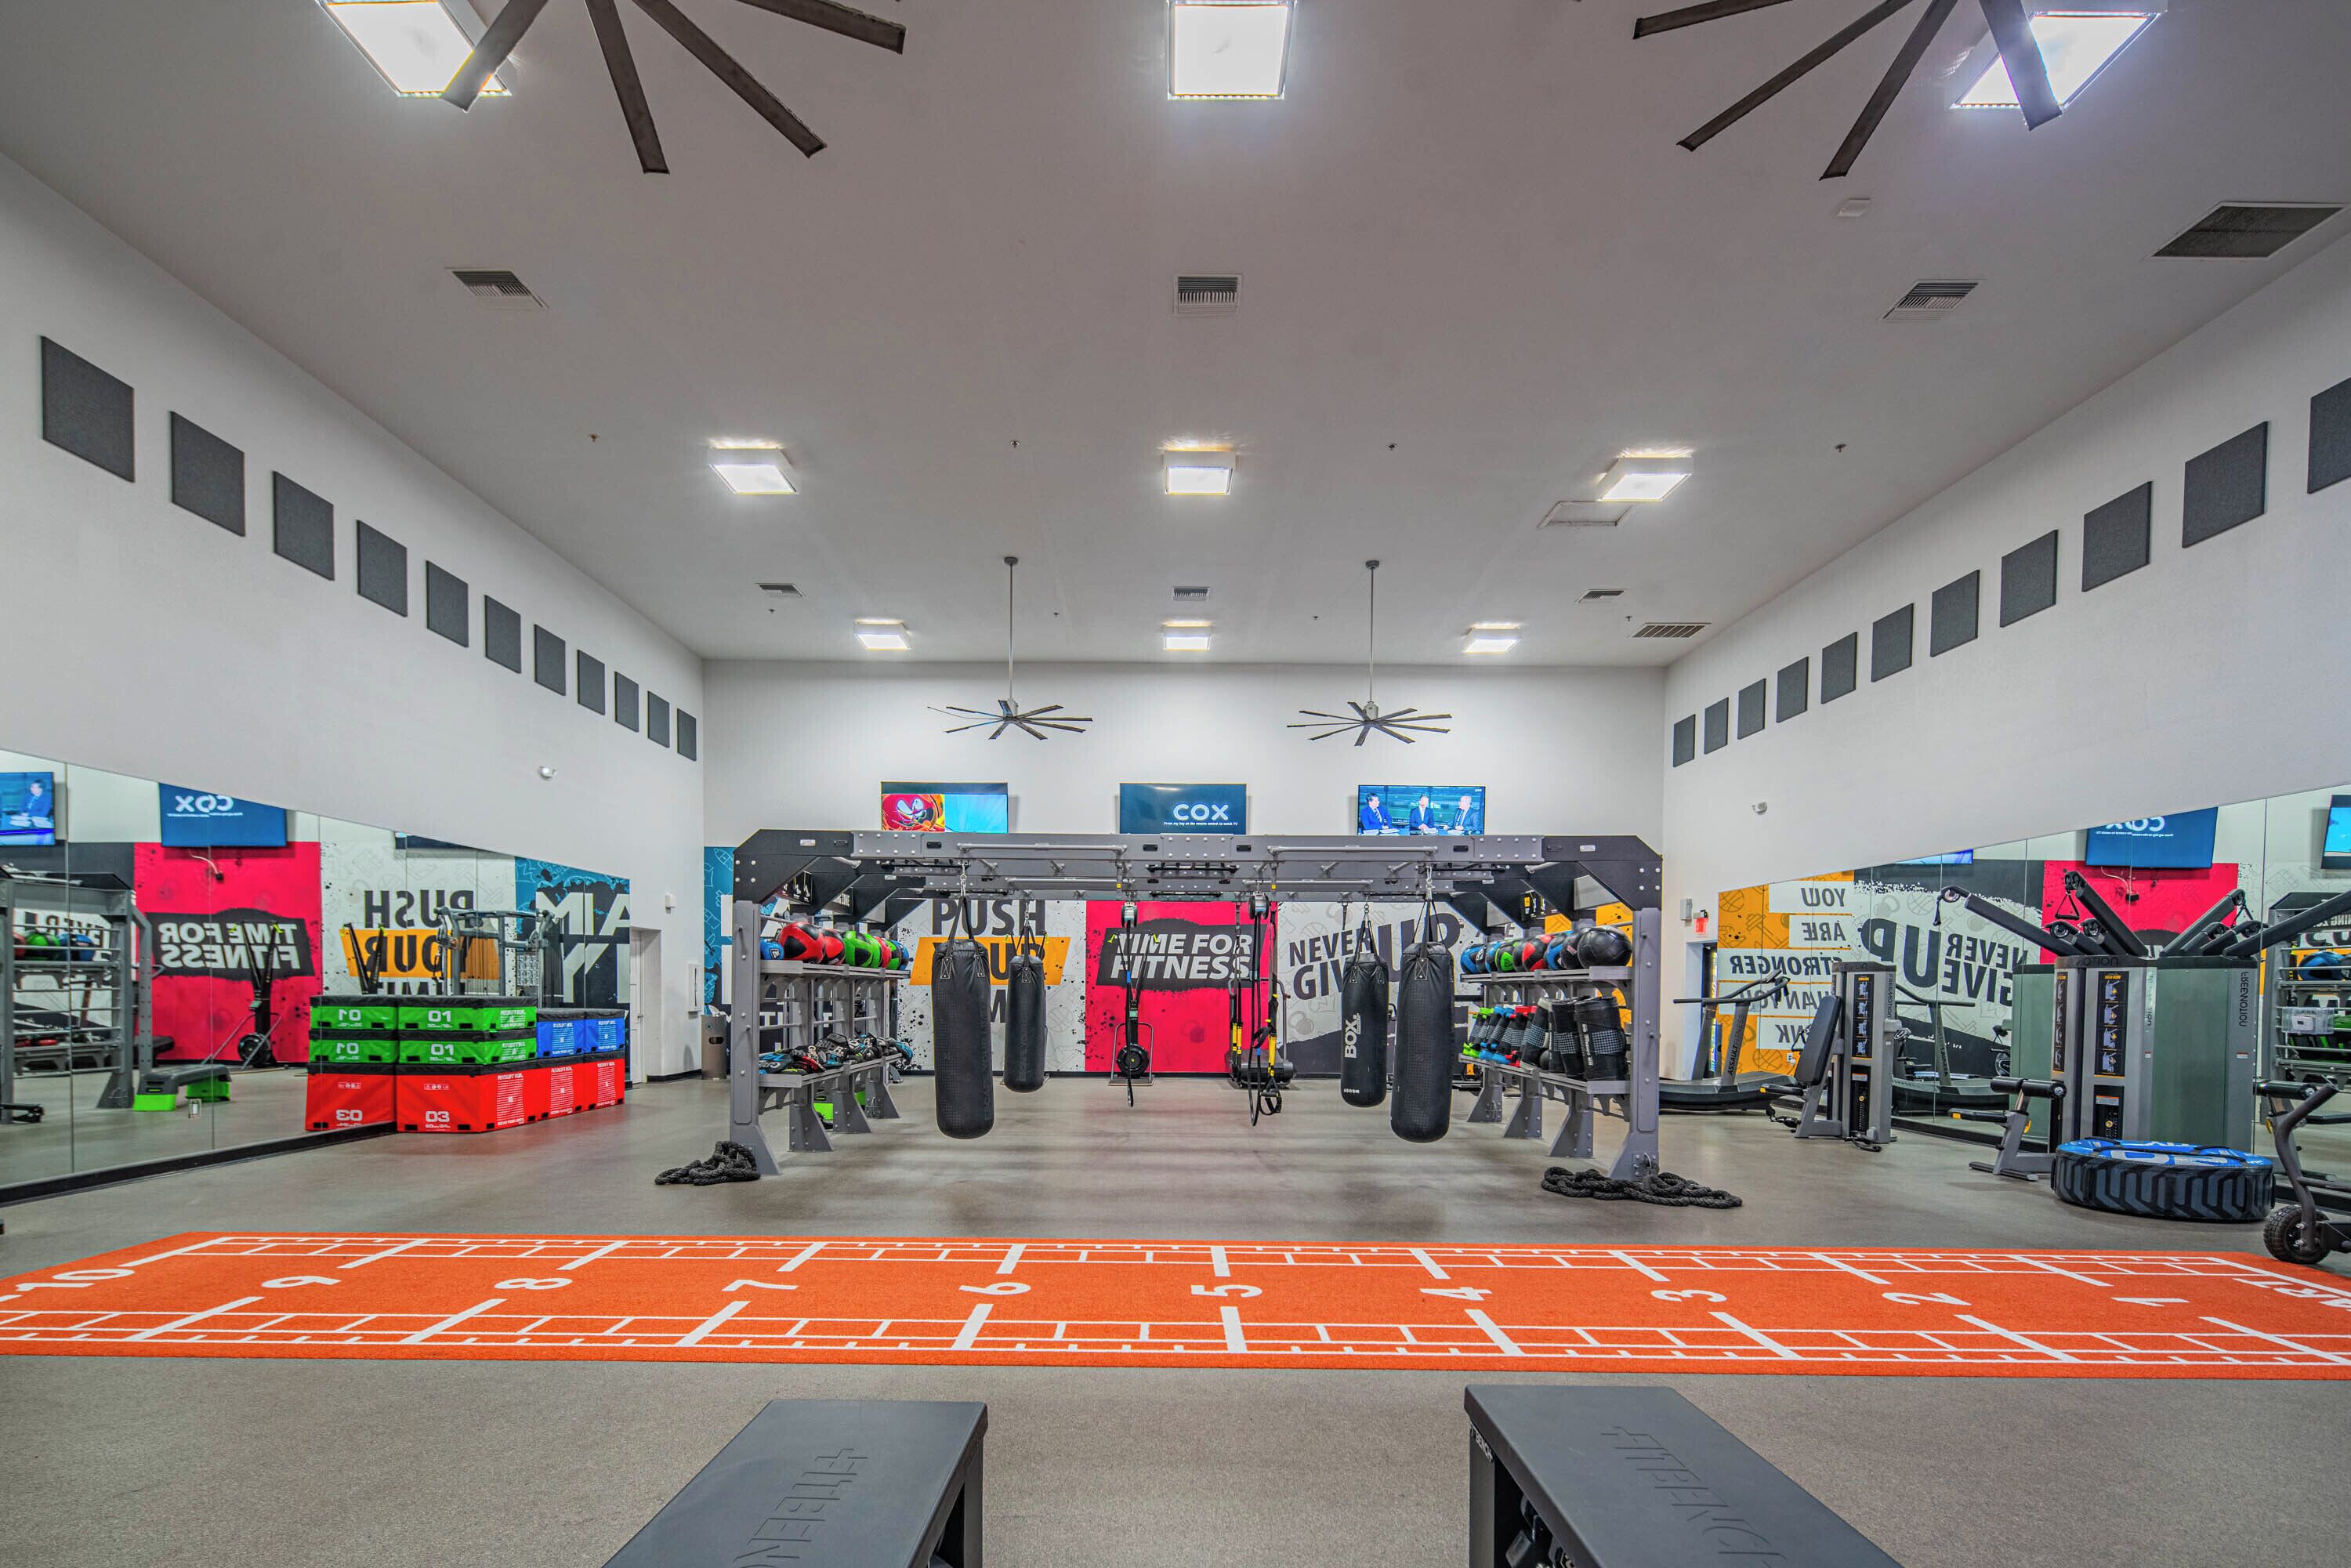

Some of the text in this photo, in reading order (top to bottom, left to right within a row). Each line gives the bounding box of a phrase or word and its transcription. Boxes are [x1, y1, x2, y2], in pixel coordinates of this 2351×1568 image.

[1173, 804, 1229, 820] COX
[932, 900, 1045, 935] PUSH
[1114, 934, 1253, 954] TIME FOR
[1289, 927, 1371, 966] NEVER
[1378, 913, 1461, 982] UP
[1111, 956, 1251, 979] FITNESS
[1294, 959, 1343, 1000] GIV
[428, 1010, 451, 1022] 01
[431, 1044, 455, 1056] 01
[1727, 1045, 1739, 1075] ASSAULT
[426, 1111, 450, 1122] 03
[16, 1269, 136, 1291] 10
[262, 1276, 342, 1289] 9
[494, 1277, 572, 1290] 8
[722, 1279, 799, 1291] 7
[959, 1282, 1031, 1295] 6
[1191, 1284, 1262, 1298] 5
[1419, 1287, 1492, 1301] 4
[1650, 1289, 1727, 1302] 3
[1882, 1291, 1972, 1305] 2
[2111, 1296, 2190, 1307] 1
